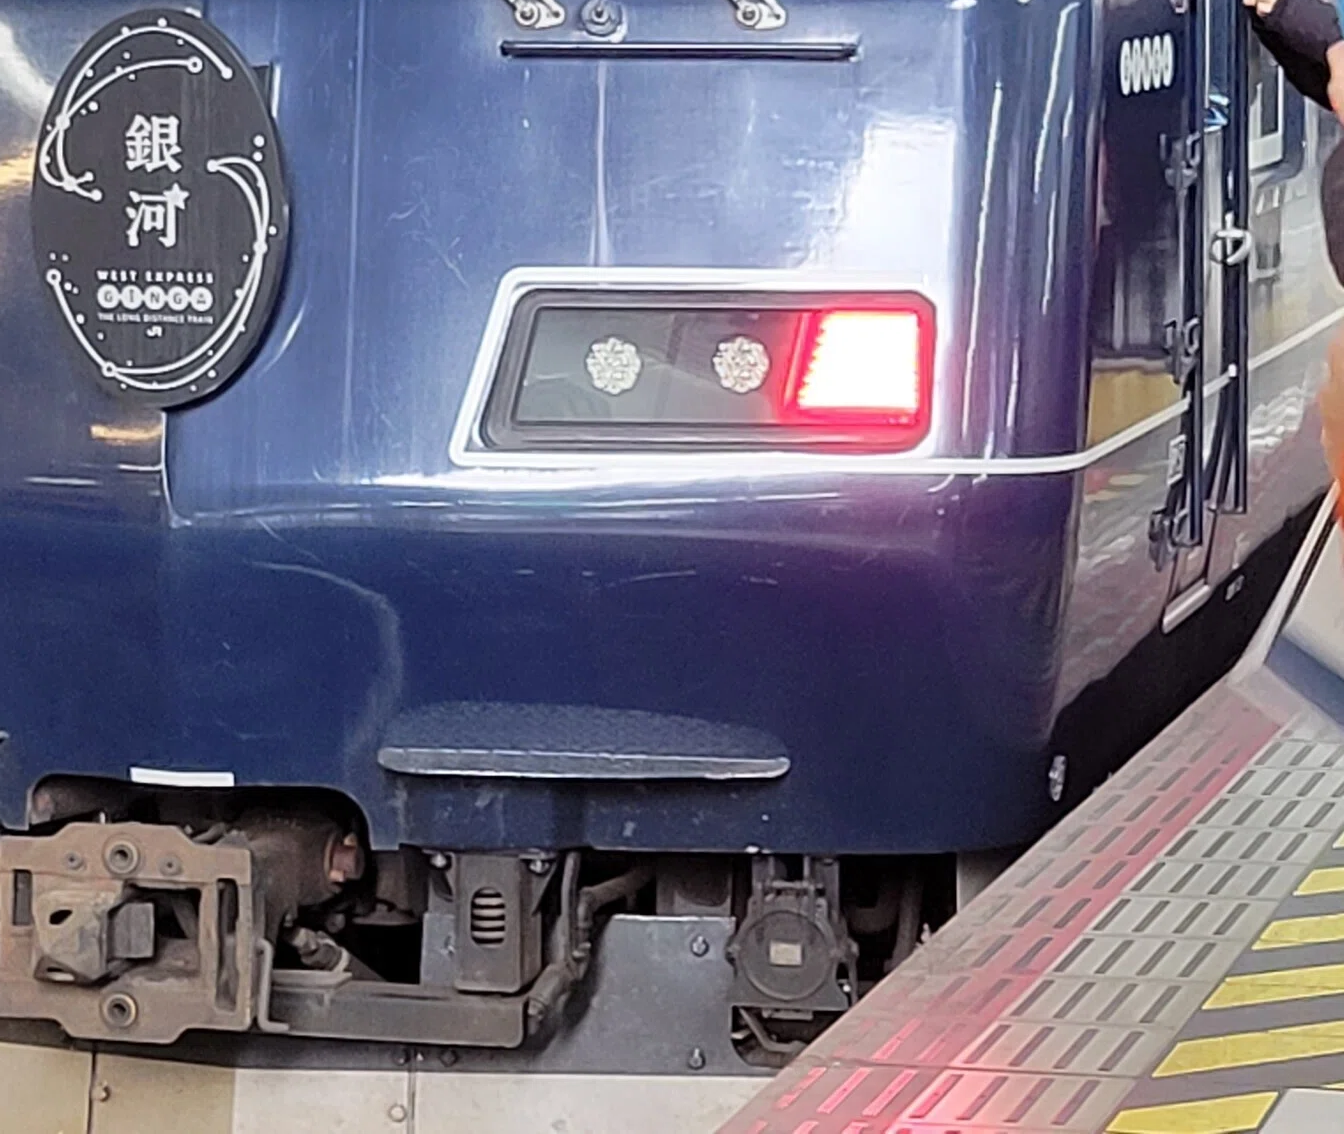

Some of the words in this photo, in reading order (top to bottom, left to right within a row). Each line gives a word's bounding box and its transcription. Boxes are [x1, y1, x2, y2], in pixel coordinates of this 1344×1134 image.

[124, 113, 190, 248] 銀河
[96, 269, 138, 283] WEST
[145, 270, 214, 284] EXPRESS
[99, 286, 211, 309] GINGA
